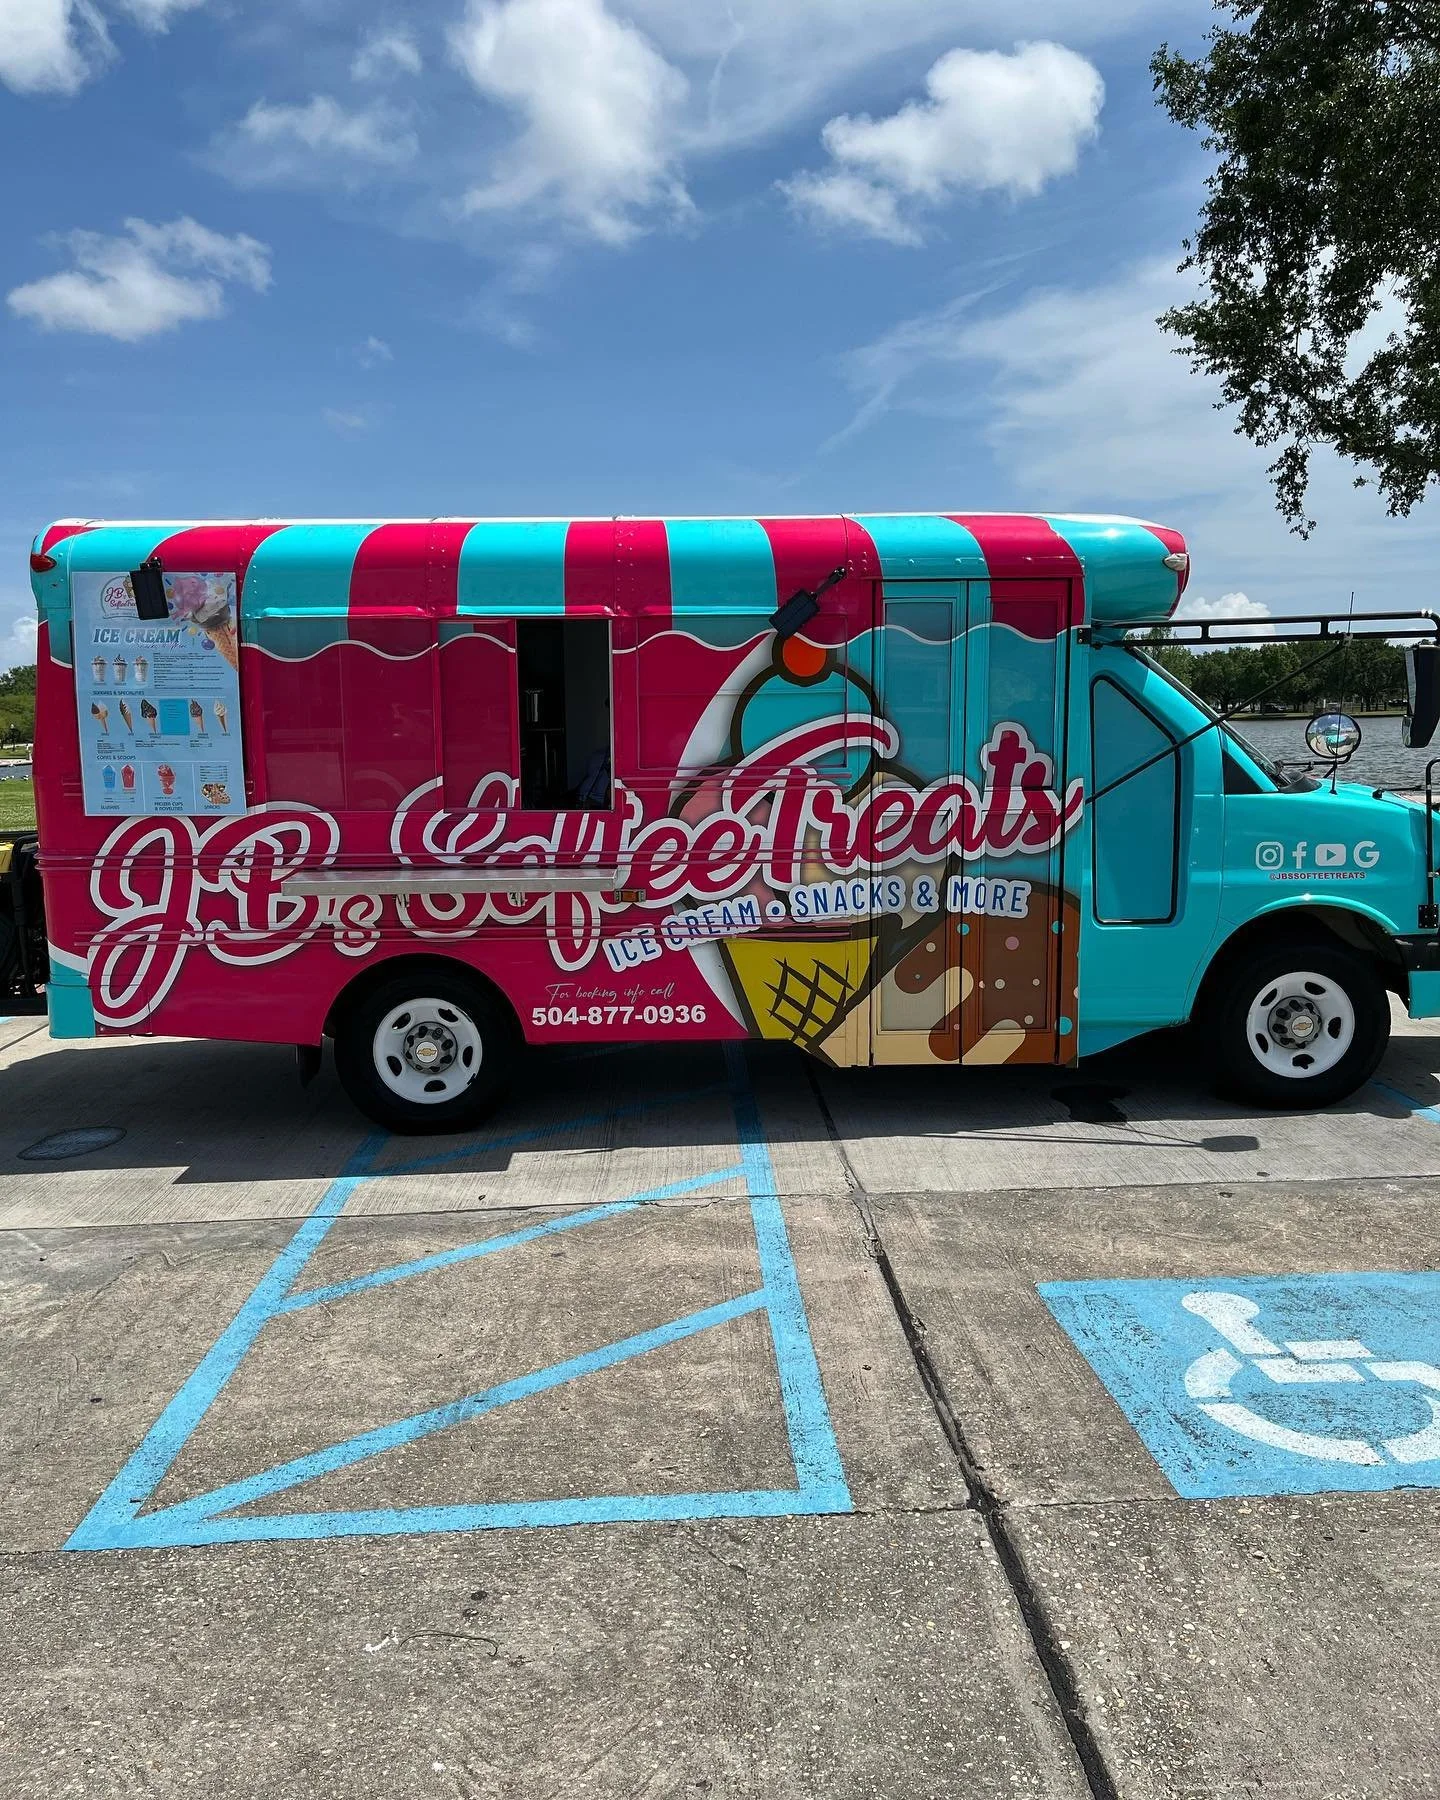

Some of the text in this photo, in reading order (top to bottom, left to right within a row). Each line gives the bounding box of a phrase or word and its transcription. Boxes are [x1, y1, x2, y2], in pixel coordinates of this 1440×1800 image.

[93, 629, 180, 643] ICE CREAM
[1269, 871, 1366, 881] @JBSSOFTEETREATS
[606, 879, 1026, 968] ICE CREAM SNACKS & MORE
[545, 982, 675, 1004] For booking info call
[531, 1004, 706, 1026] 504-877-0936
